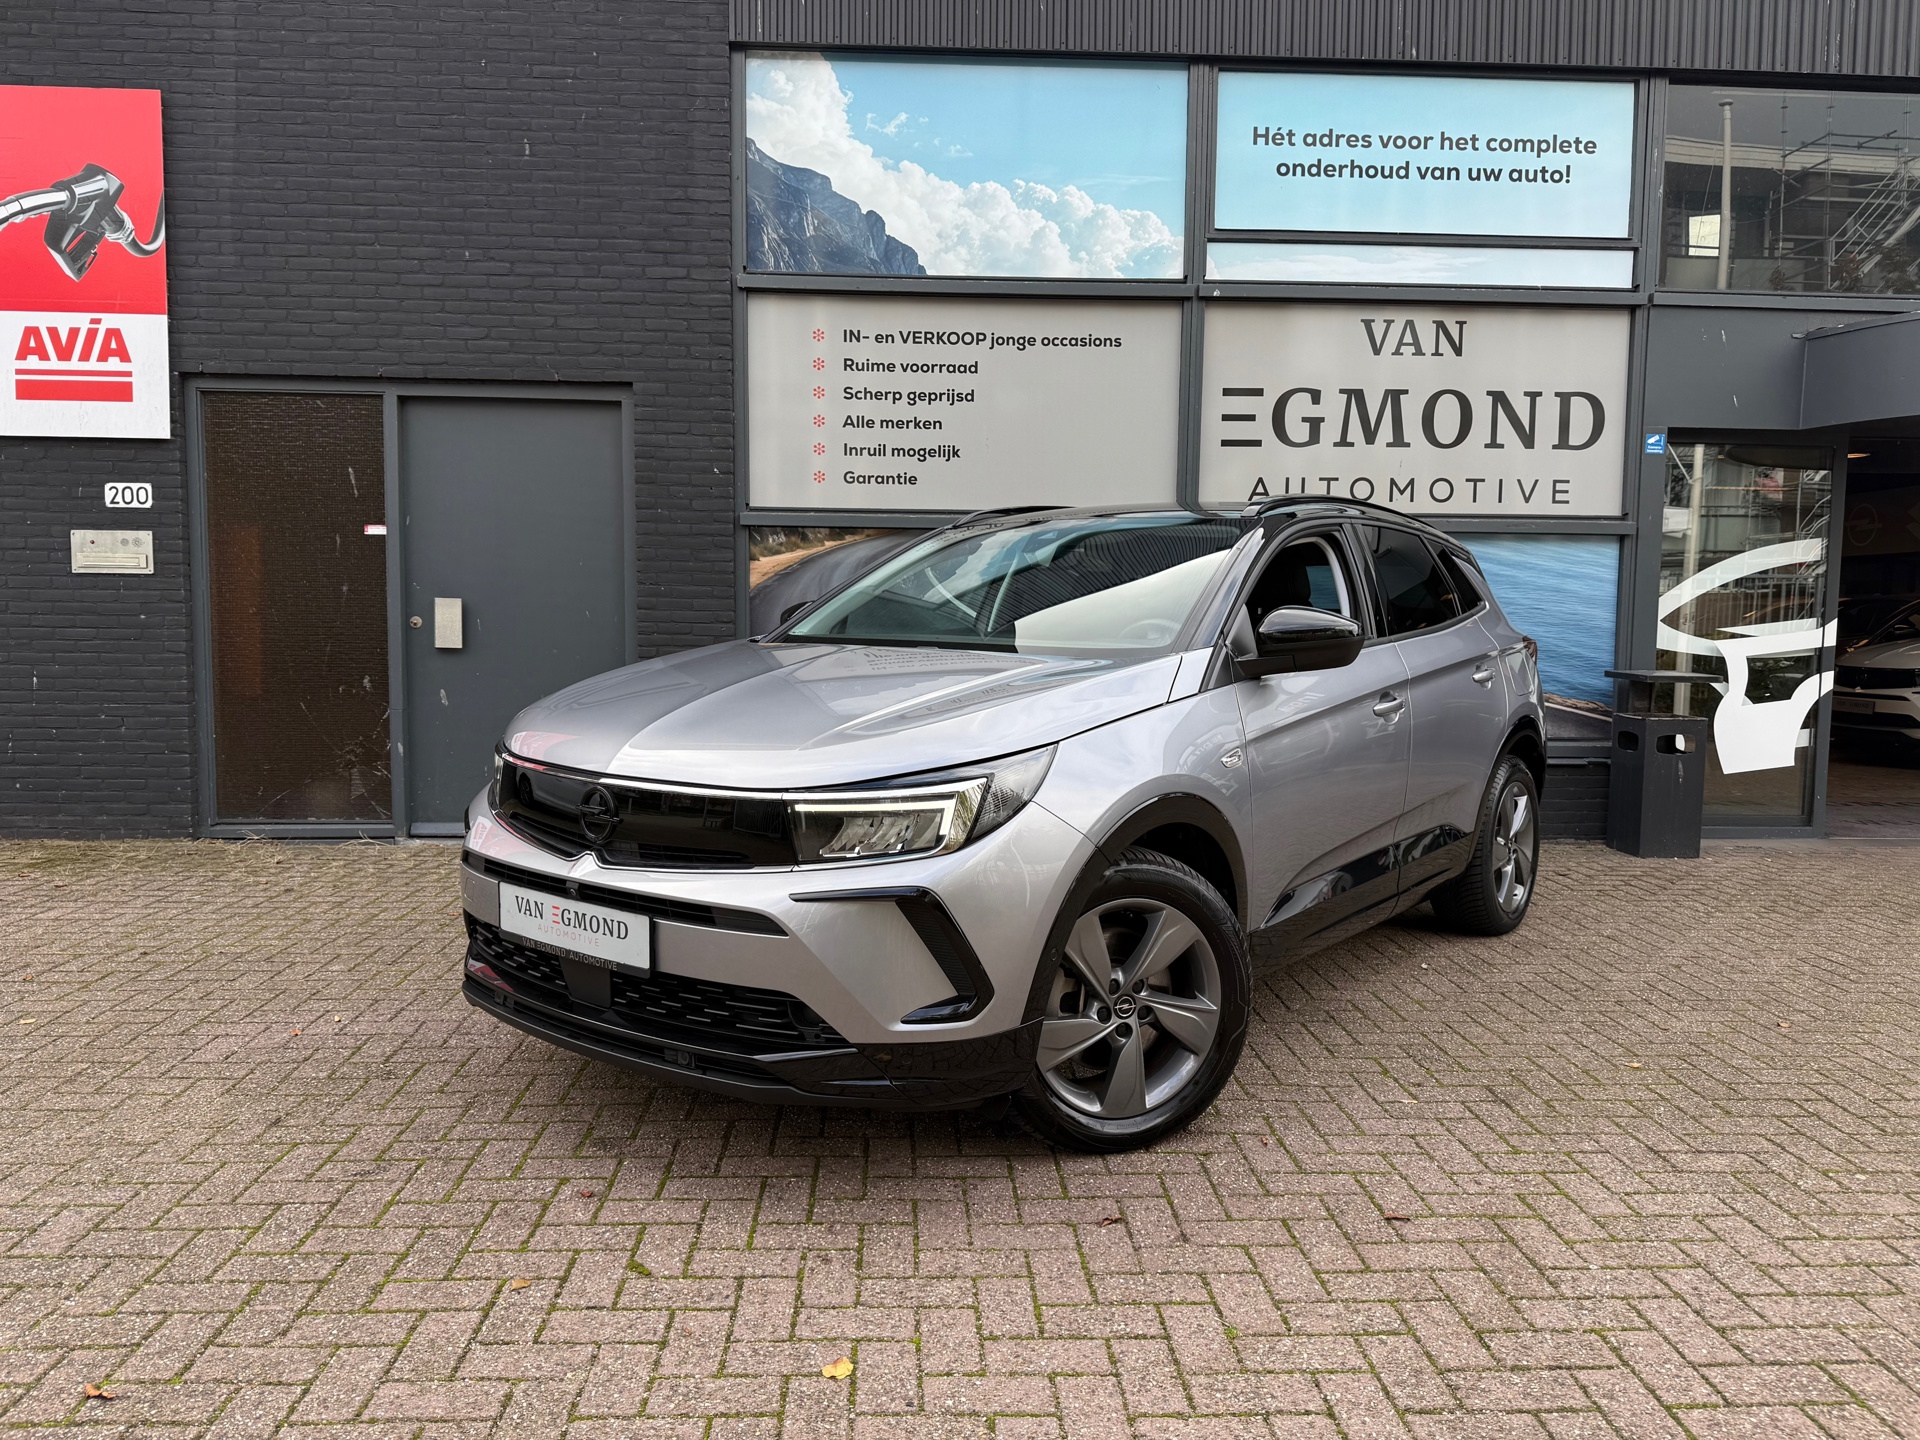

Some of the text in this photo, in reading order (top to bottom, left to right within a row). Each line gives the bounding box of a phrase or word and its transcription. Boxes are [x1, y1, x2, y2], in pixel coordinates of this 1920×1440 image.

[1252, 126, 1597, 157] Hét adres voor het complete
[1276, 158, 1571, 184] onderhoud van uw auto!
[843, 329, 1122, 351] IN- en VERKOOP jonge occasions
[1360, 318, 1468, 357] VAN
[843, 357, 979, 375] Ruime voorraad
[843, 385, 975, 407] Scherp geprijsd
[842, 414, 943, 430] Alle merken
[1220, 387, 1606, 451] EGMOND
[843, 442, 961, 463] Inruil mogelijk
[843, 470, 918, 486] Garantie
[109, 486, 149, 505] 200
[1247, 477, 1571, 504] AUTOMOTIVE
[515, 895, 629, 940] VAN EGMOND
[537, 923, 600, 947] AUTOMOTIVE
[522, 937, 536, 949] VAN
[569, 951, 618, 971] AUTOMOTIVE
